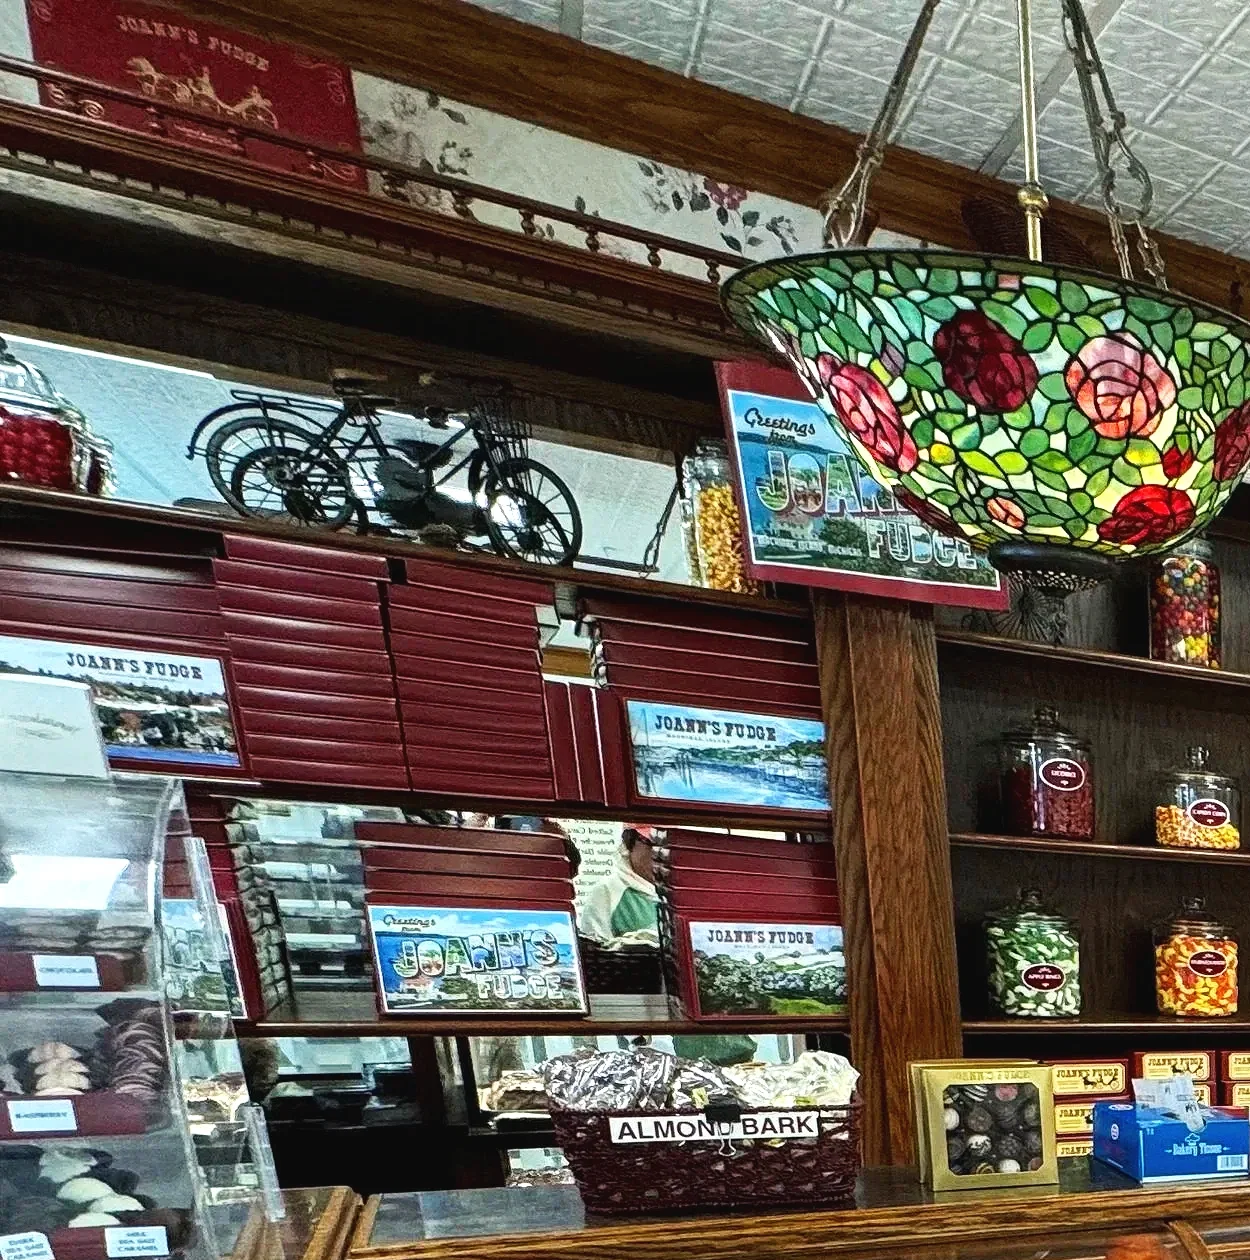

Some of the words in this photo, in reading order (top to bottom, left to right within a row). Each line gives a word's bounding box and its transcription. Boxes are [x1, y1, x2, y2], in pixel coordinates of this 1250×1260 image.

[744, 408, 816, 437] Greetings
[865, 519, 977, 569] FUDGE
[66, 652, 140, 673] JOANN'S
[144, 661, 203, 680] FUDGE
[654, 715, 721, 736] JOANN'S
[724, 722, 777, 741] FUDGE
[383, 914, 436, 929] Greetings
[708, 929, 766, 943] JOANN'S
[768, 931, 814, 944] FUDGE
[393, 929, 559, 978] JOANN'S
[476, 973, 564, 999] FUDGE
[1056, 1069, 1090, 1078] JOANN'S
[1092, 1068, 1119, 1077] FUDGE
[742, 1115, 814, 1135] BARK
